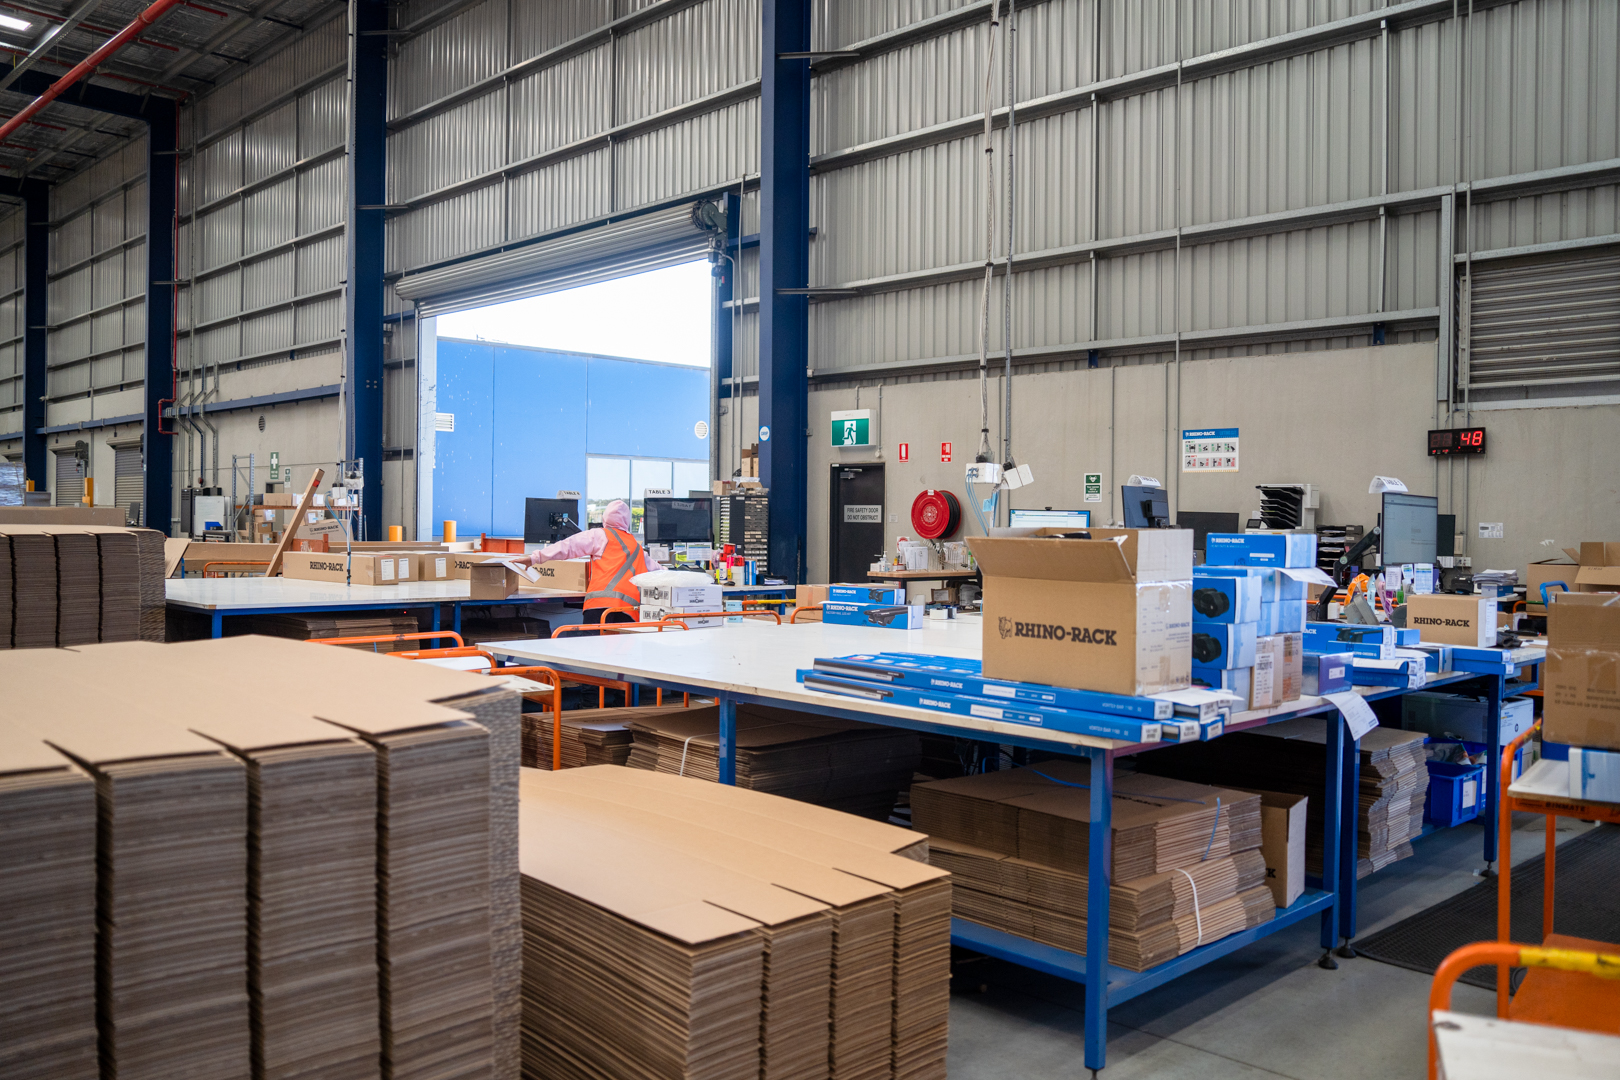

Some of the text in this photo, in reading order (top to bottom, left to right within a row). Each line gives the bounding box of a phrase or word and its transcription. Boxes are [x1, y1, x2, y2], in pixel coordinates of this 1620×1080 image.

[1461, 430, 1483, 446] 48
[310, 561, 344, 572] RHINO-RACK
[1414, 617, 1470, 628] RHINO-RACK
[1015, 621, 1117, 646] RHINO-RACK
[934, 679, 963, 689] RHINO-RACK
[923, 698, 951, 709] RHINO-RACK
